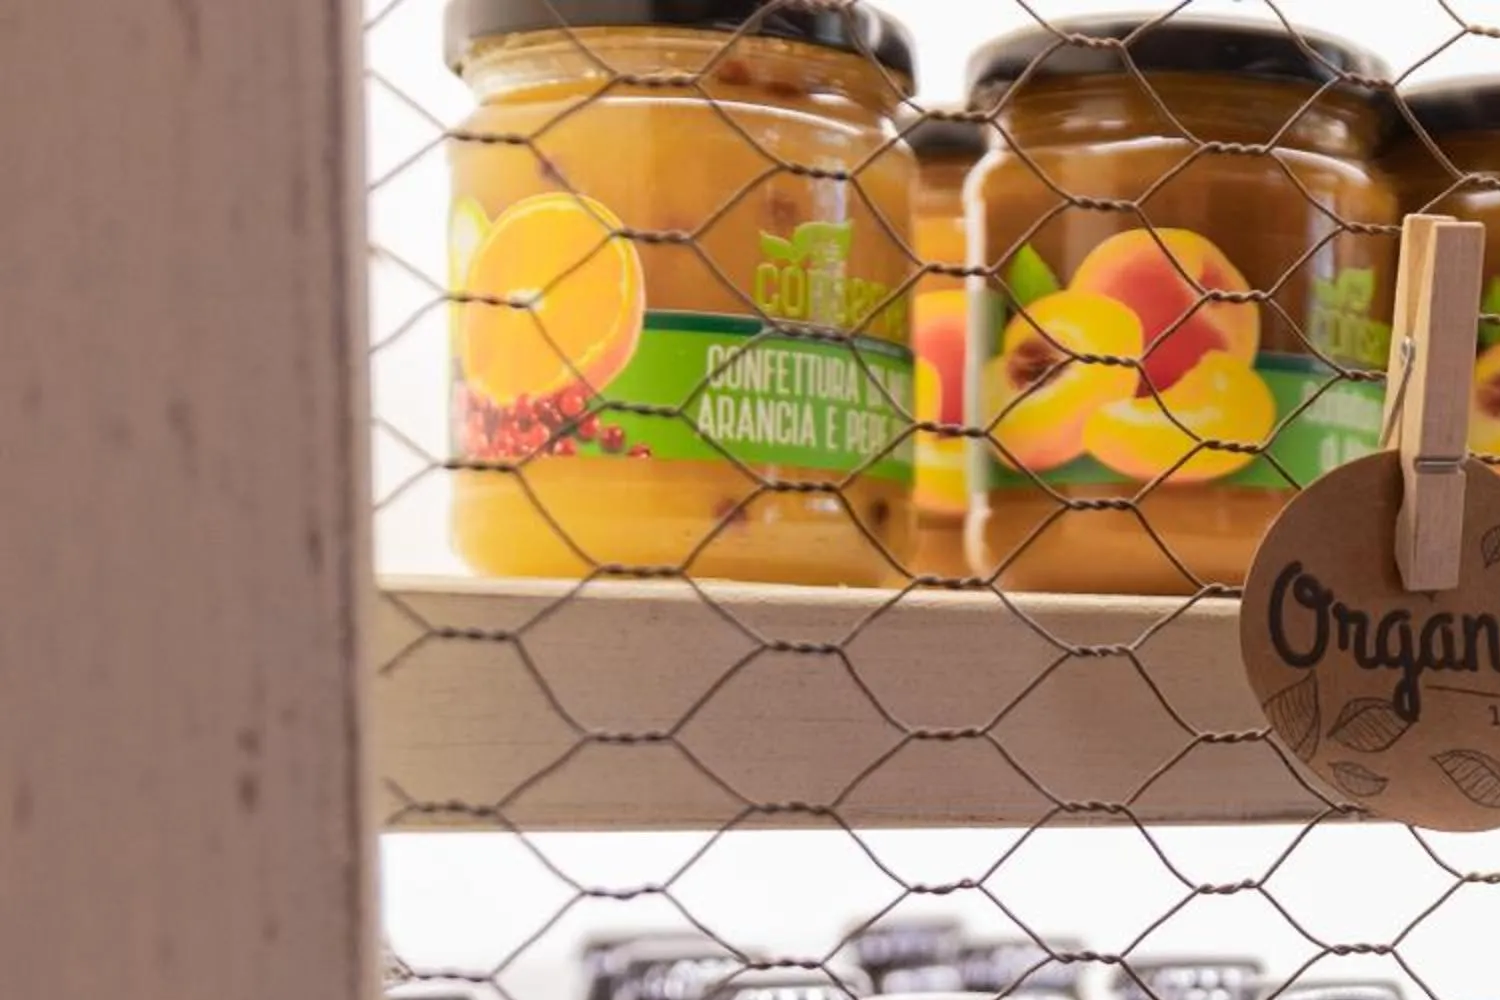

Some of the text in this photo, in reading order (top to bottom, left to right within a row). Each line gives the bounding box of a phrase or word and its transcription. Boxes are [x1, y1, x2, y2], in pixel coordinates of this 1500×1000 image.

[706, 344, 860, 404] CONFETTURA
[697, 394, 817, 448] ARANCIA
[825, 405, 839, 450] E
